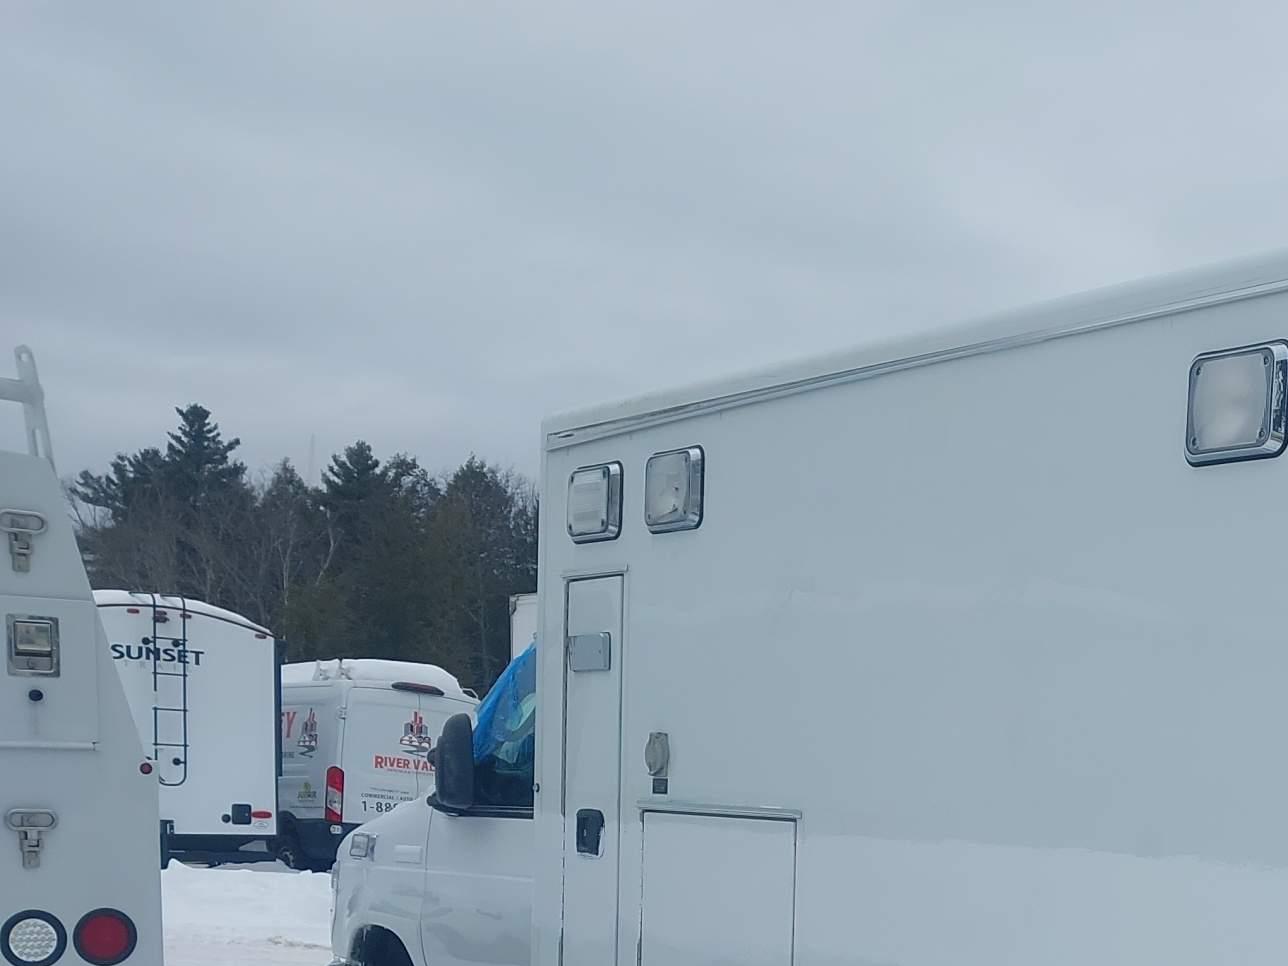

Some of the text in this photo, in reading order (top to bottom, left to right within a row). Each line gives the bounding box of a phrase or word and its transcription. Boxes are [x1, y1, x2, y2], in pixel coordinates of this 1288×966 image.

[110, 643, 205, 666] SUNSET
[374, 755, 410, 769] RIVER
[360, 792, 394, 800] COMMERCIAL
[361, 800, 399, 813] 1-88
